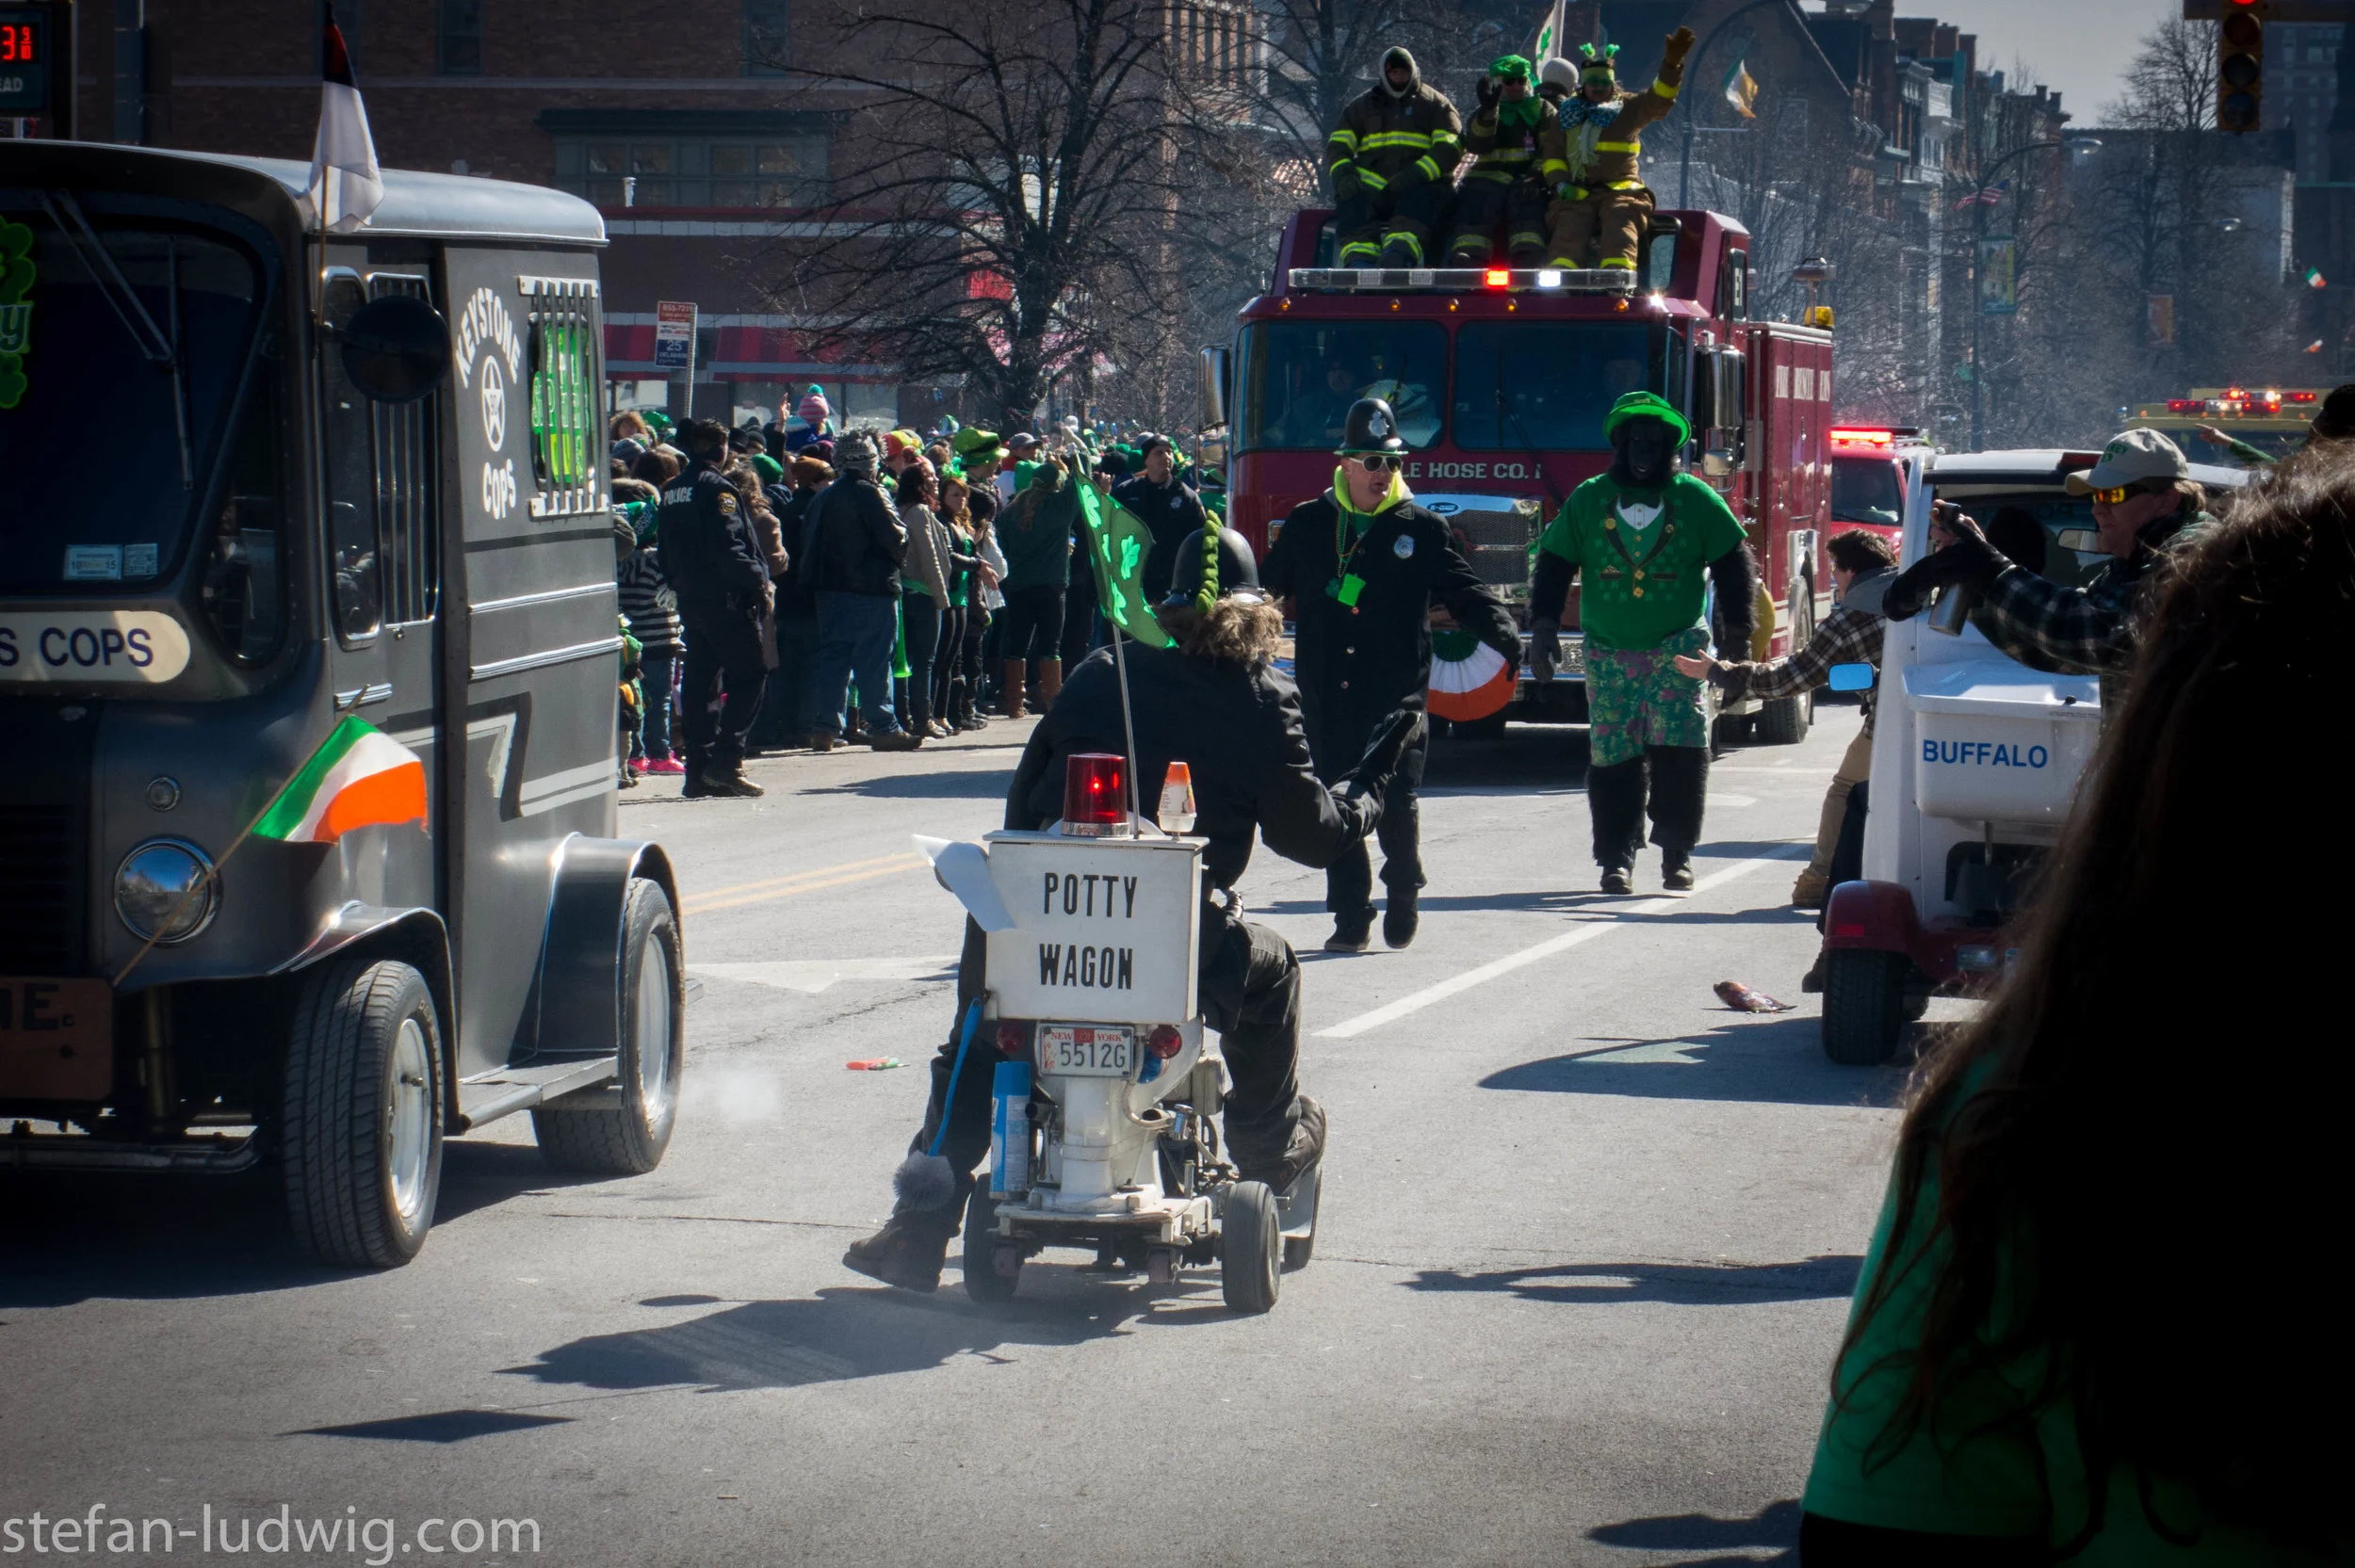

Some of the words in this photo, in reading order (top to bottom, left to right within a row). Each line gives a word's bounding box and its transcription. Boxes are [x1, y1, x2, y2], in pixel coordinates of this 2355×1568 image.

[0, 77, 24, 92] AD
[456, 287, 521, 389] KEYSTONE
[667, 340, 683, 352] 25
[1428, 462, 1487, 479] HOSE
[1493, 463, 1529, 479] CO.
[482, 459, 517, 519] COPS
[663, 486, 693, 507] POLICE
[40, 627, 154, 668] COPS
[1923, 739, 2048, 768] BUFFALO
[1044, 872, 1138, 918] POTTY
[1039, 944, 1133, 990] WAGON
[1050, 1032, 1074, 1041] NEW
[1096, 1033, 1123, 1043] YORK
[1061, 1043, 1127, 1069] 5512G
